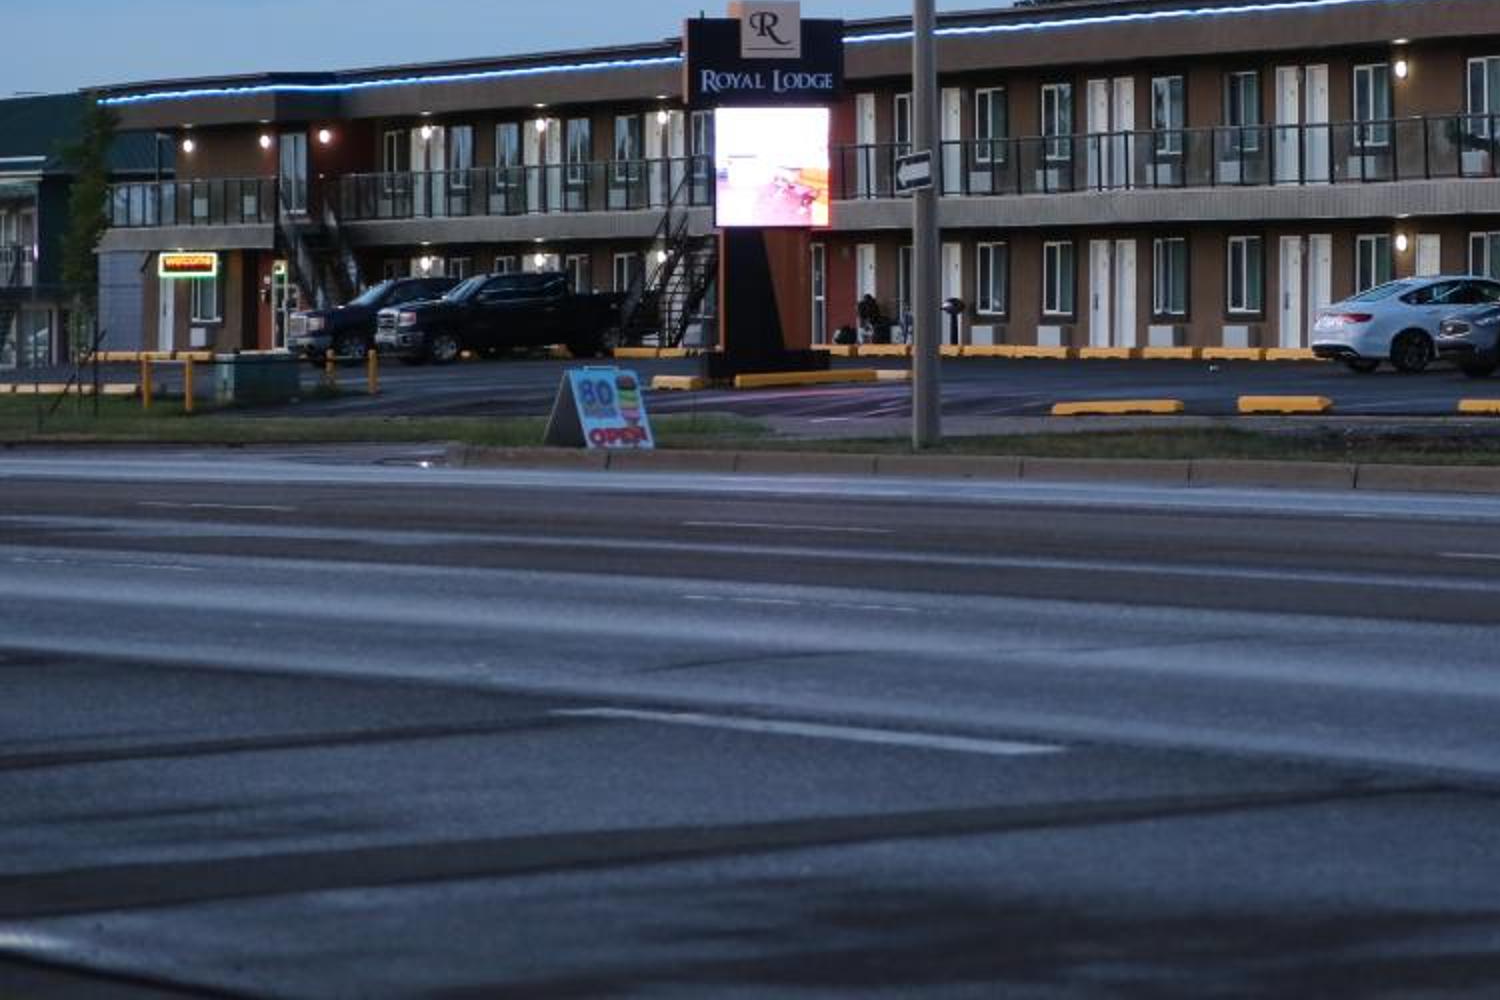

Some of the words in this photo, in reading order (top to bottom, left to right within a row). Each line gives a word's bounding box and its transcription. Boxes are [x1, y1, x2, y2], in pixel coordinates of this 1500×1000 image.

[749, 11, 791, 45] R
[700, 69, 766, 93] ROYAL
[772, 69, 833, 93] LODGE
